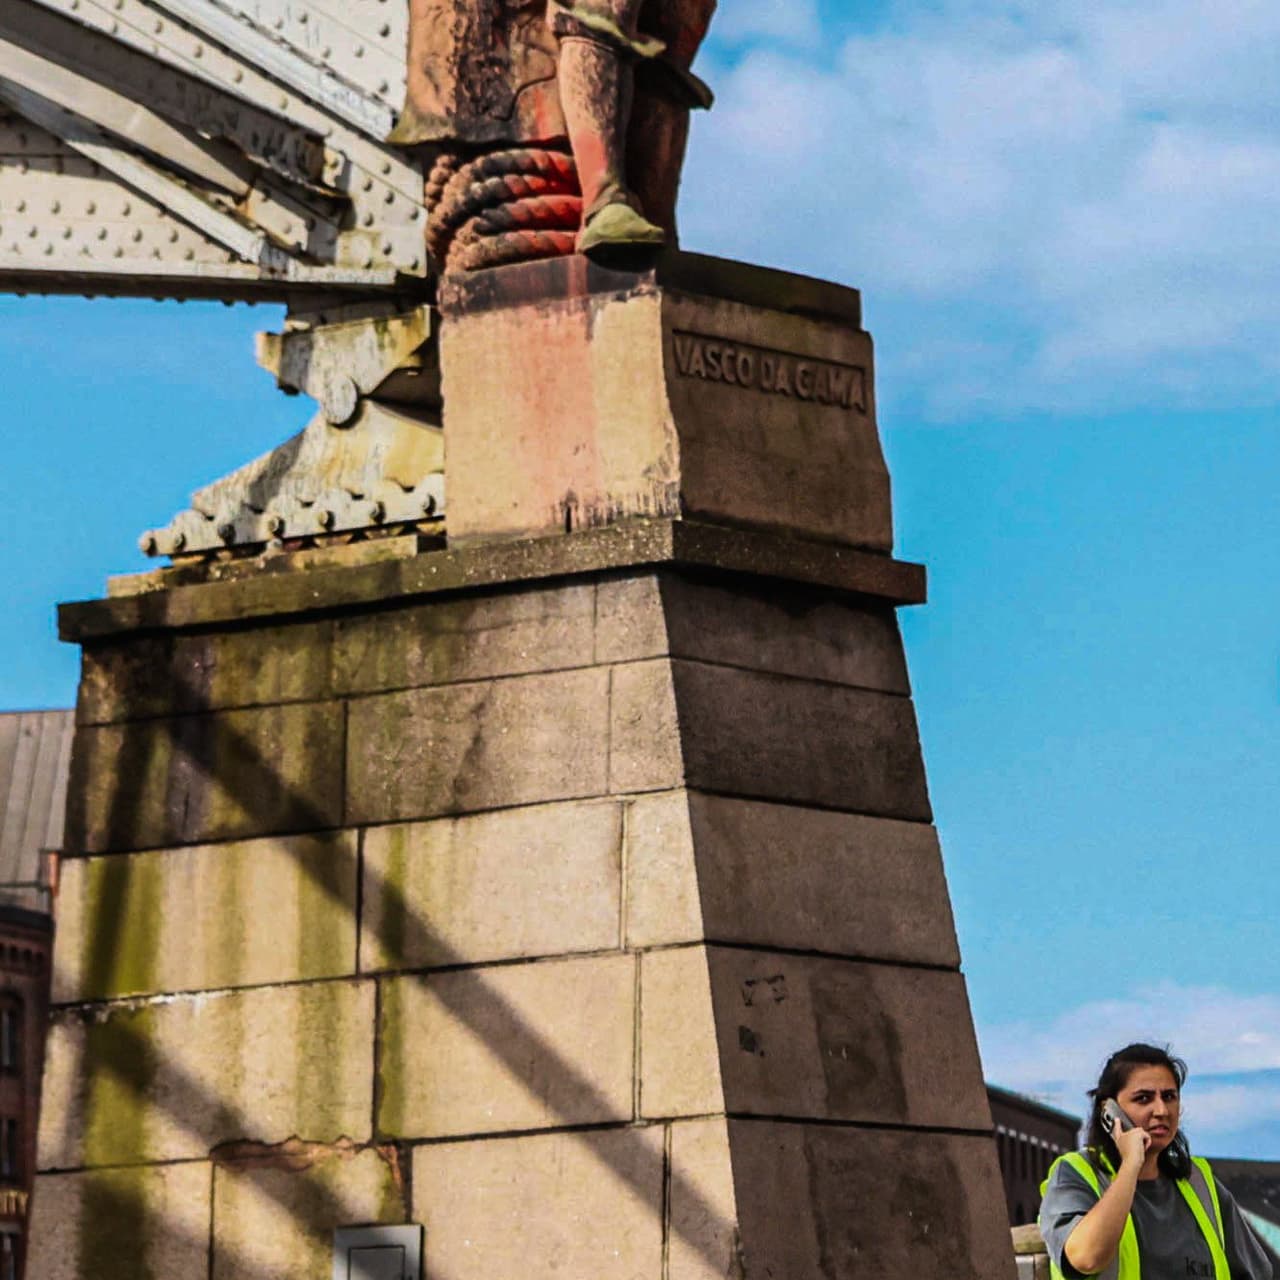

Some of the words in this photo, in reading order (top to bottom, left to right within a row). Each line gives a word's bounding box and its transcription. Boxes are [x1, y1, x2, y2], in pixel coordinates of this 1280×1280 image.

[674, 334, 754, 388] VASCO
[760, 355, 792, 397] DA
[795, 361, 867, 415] GAMA
